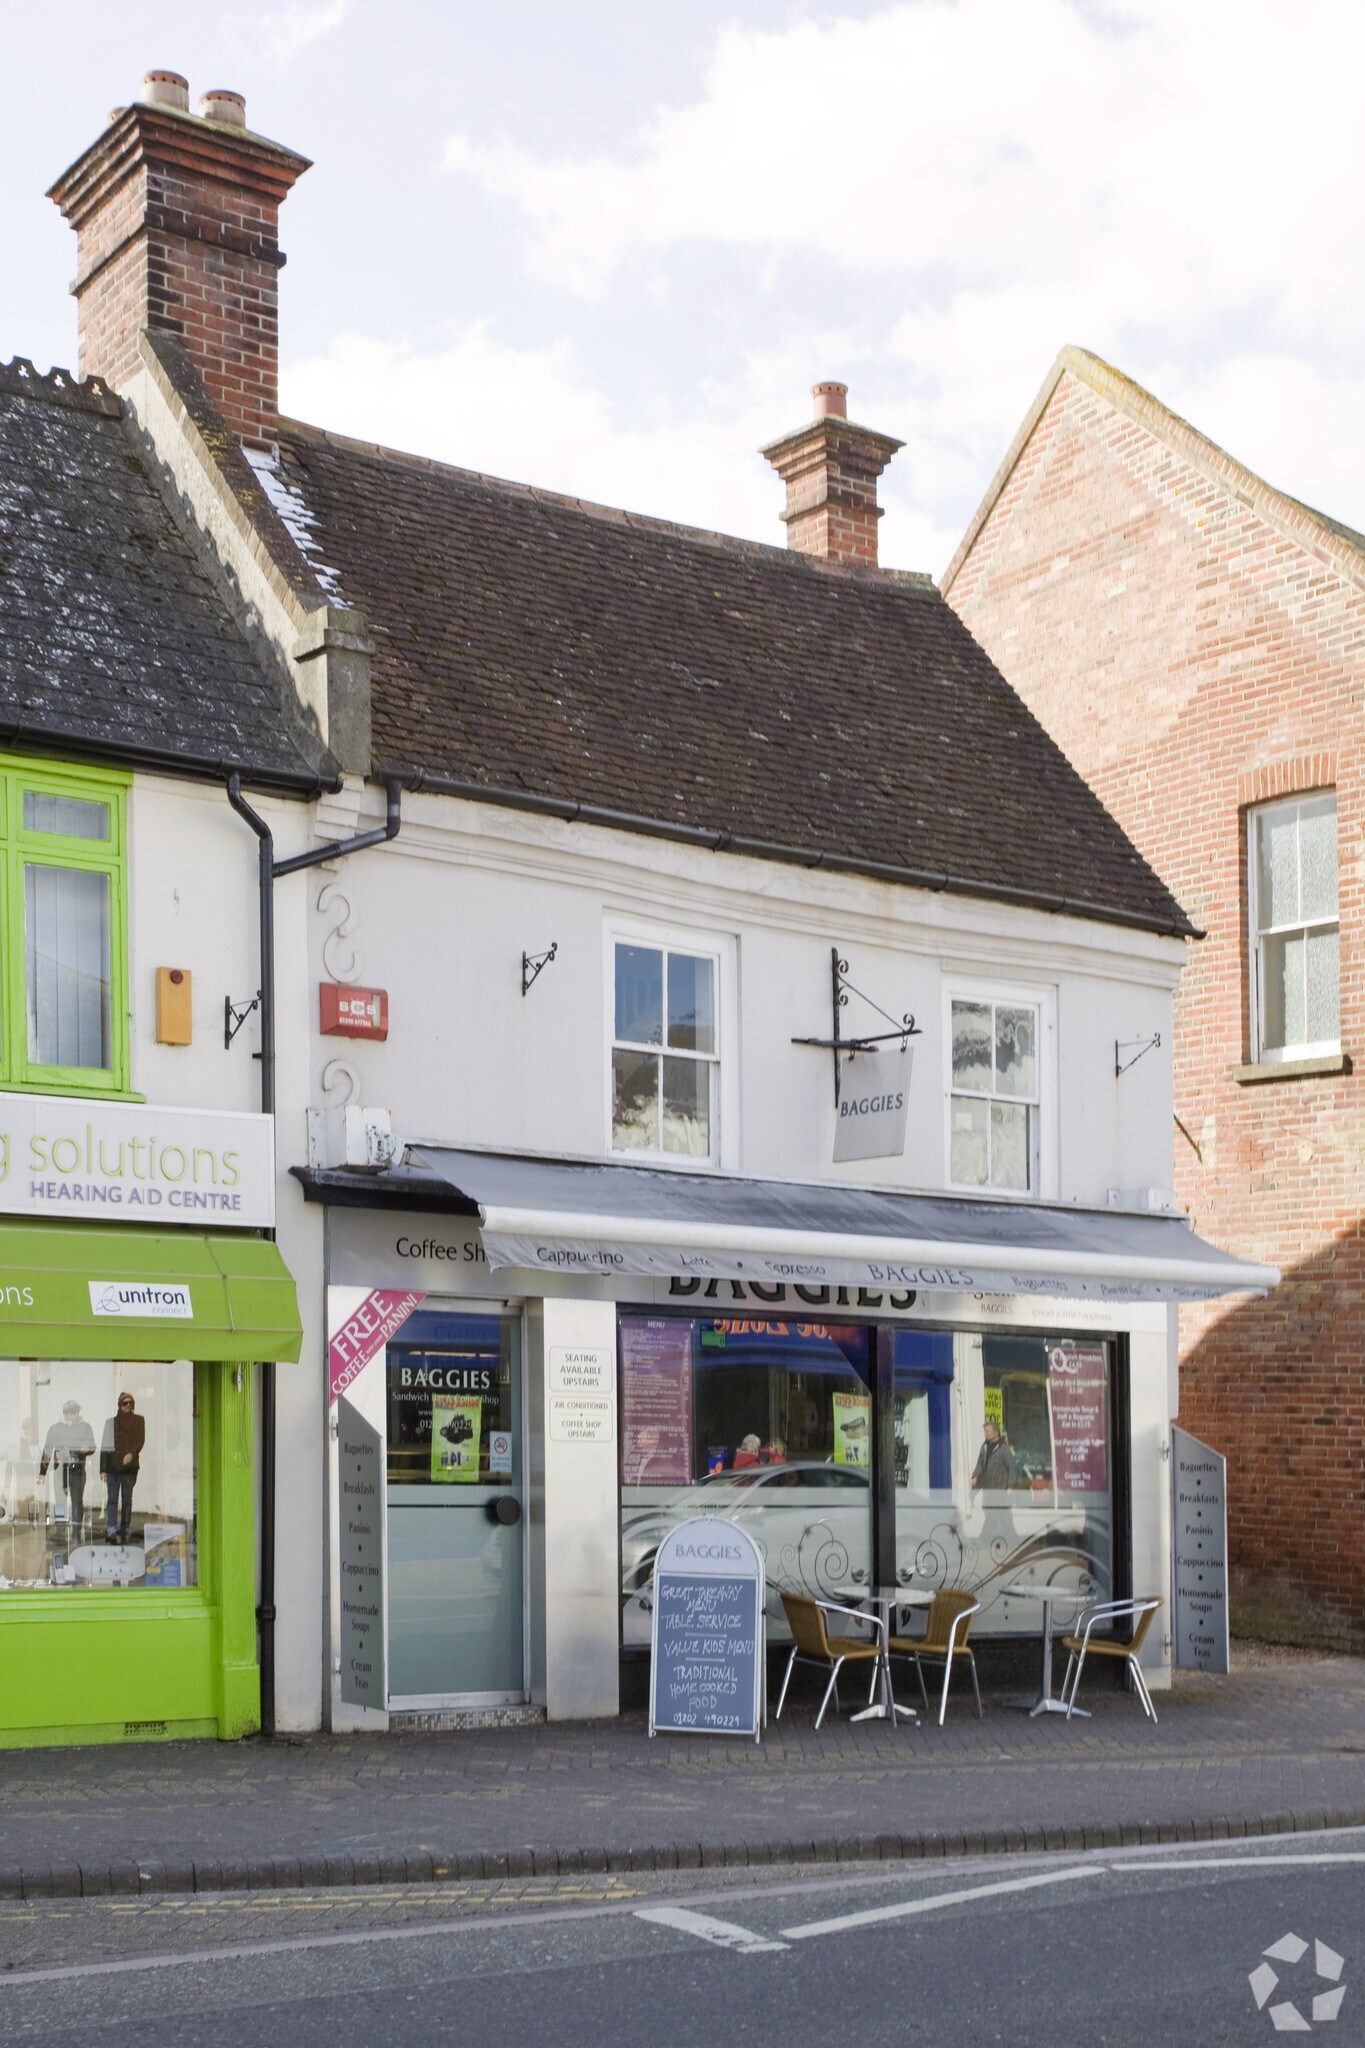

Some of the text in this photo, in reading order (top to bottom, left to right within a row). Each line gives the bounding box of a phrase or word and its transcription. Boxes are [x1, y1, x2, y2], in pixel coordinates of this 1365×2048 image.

[840, 1093, 904, 1117] BAGGIES
[30, 1123, 241, 1186] solutions
[30, 1180, 242, 1212] HEARING AID CENTRE
[396, 1237, 487, 1262] Coffee Sh
[868, 1263, 974, 1286] BAGGIES
[118, 1287, 185, 1305] unitron
[152, 1306, 188, 1315] connect
[332, 1290, 393, 1363] FREE
[647, 1320, 666, 1329] MENU
[332, 1349, 369, 1395] COFFEE
[380, 1293, 418, 1338] PANINI
[565, 1353, 597, 1363] SEATING
[560, 1365, 603, 1376] AVAILABLE
[401, 1367, 490, 1389] BAGGIES
[563, 1377, 599, 1387] UPSTAIRS
[392, 1391, 429, 1402] Sandwich
[481, 1394, 499, 1405] Shop
[554, 1401, 608, 1410] AIR CONDITIONED
[562, 1420, 601, 1429] COFFEE SHOP
[568, 1430, 595, 1438] UPSTAIRS
[344, 1443, 374, 1456] Baguettes
[1180, 1462, 1217, 1473] Baguettes
[343, 1481, 375, 1495] Breakfasts
[1179, 1493, 1219, 1503] Breakfasts
[348, 1521, 371, 1535] Paninis
[1185, 1524, 1213, 1535] Paninis
[675, 1544, 742, 1559] BAGGIES
[342, 1561, 379, 1576] Cappuccino
[1177, 1556, 1224, 1568] Cappuccino
[661, 1584, 743, 1602] GREAT TAKEAWAY
[1178, 1586, 1223, 1599] Homemade
[343, 1601, 379, 1616] Homemade
[686, 1598, 717, 1613] MENU
[1189, 1601, 1212, 1614] Soups
[351, 1618, 370, 1634] Soups
[661, 1613, 742, 1629] TABLE SERVICE
[1189, 1632, 1215, 1645] Cream
[664, 1639, 754, 1658] VALUE KIDS MENU
[1194, 1646, 1211, 1657] Teas
[350, 1658, 372, 1672] Cream
[673, 1665, 738, 1682] TRADITIONAL
[355, 1676, 369, 1689] Teas
[670, 1682, 737, 1699] HOME COOKED
[689, 1695, 717, 1712] FOOD
[673, 1712, 740, 1727] 01202 490229
